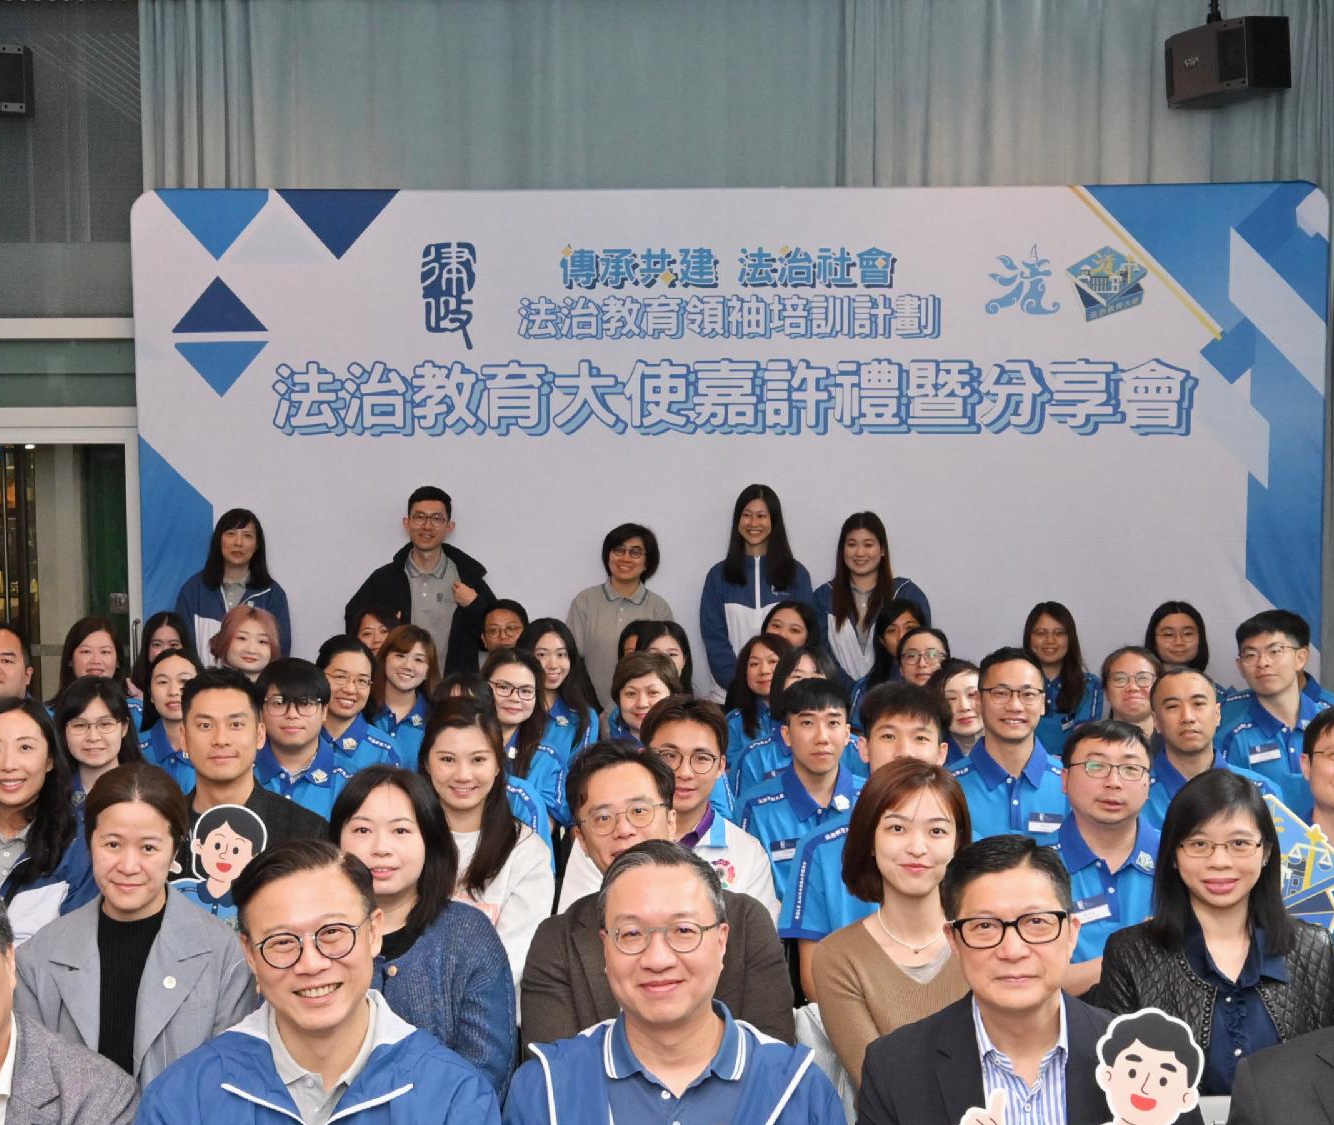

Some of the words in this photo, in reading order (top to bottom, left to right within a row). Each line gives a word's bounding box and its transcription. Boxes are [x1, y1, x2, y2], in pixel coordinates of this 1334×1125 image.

[560, 245, 717, 289] 傳承共建
[738, 246, 897, 289] 法治社會
[517, 294, 941, 341] 法治教育領袖培訓計劃
[272, 357, 1199, 437] 法治教育大使嘉許禮暨分享會
